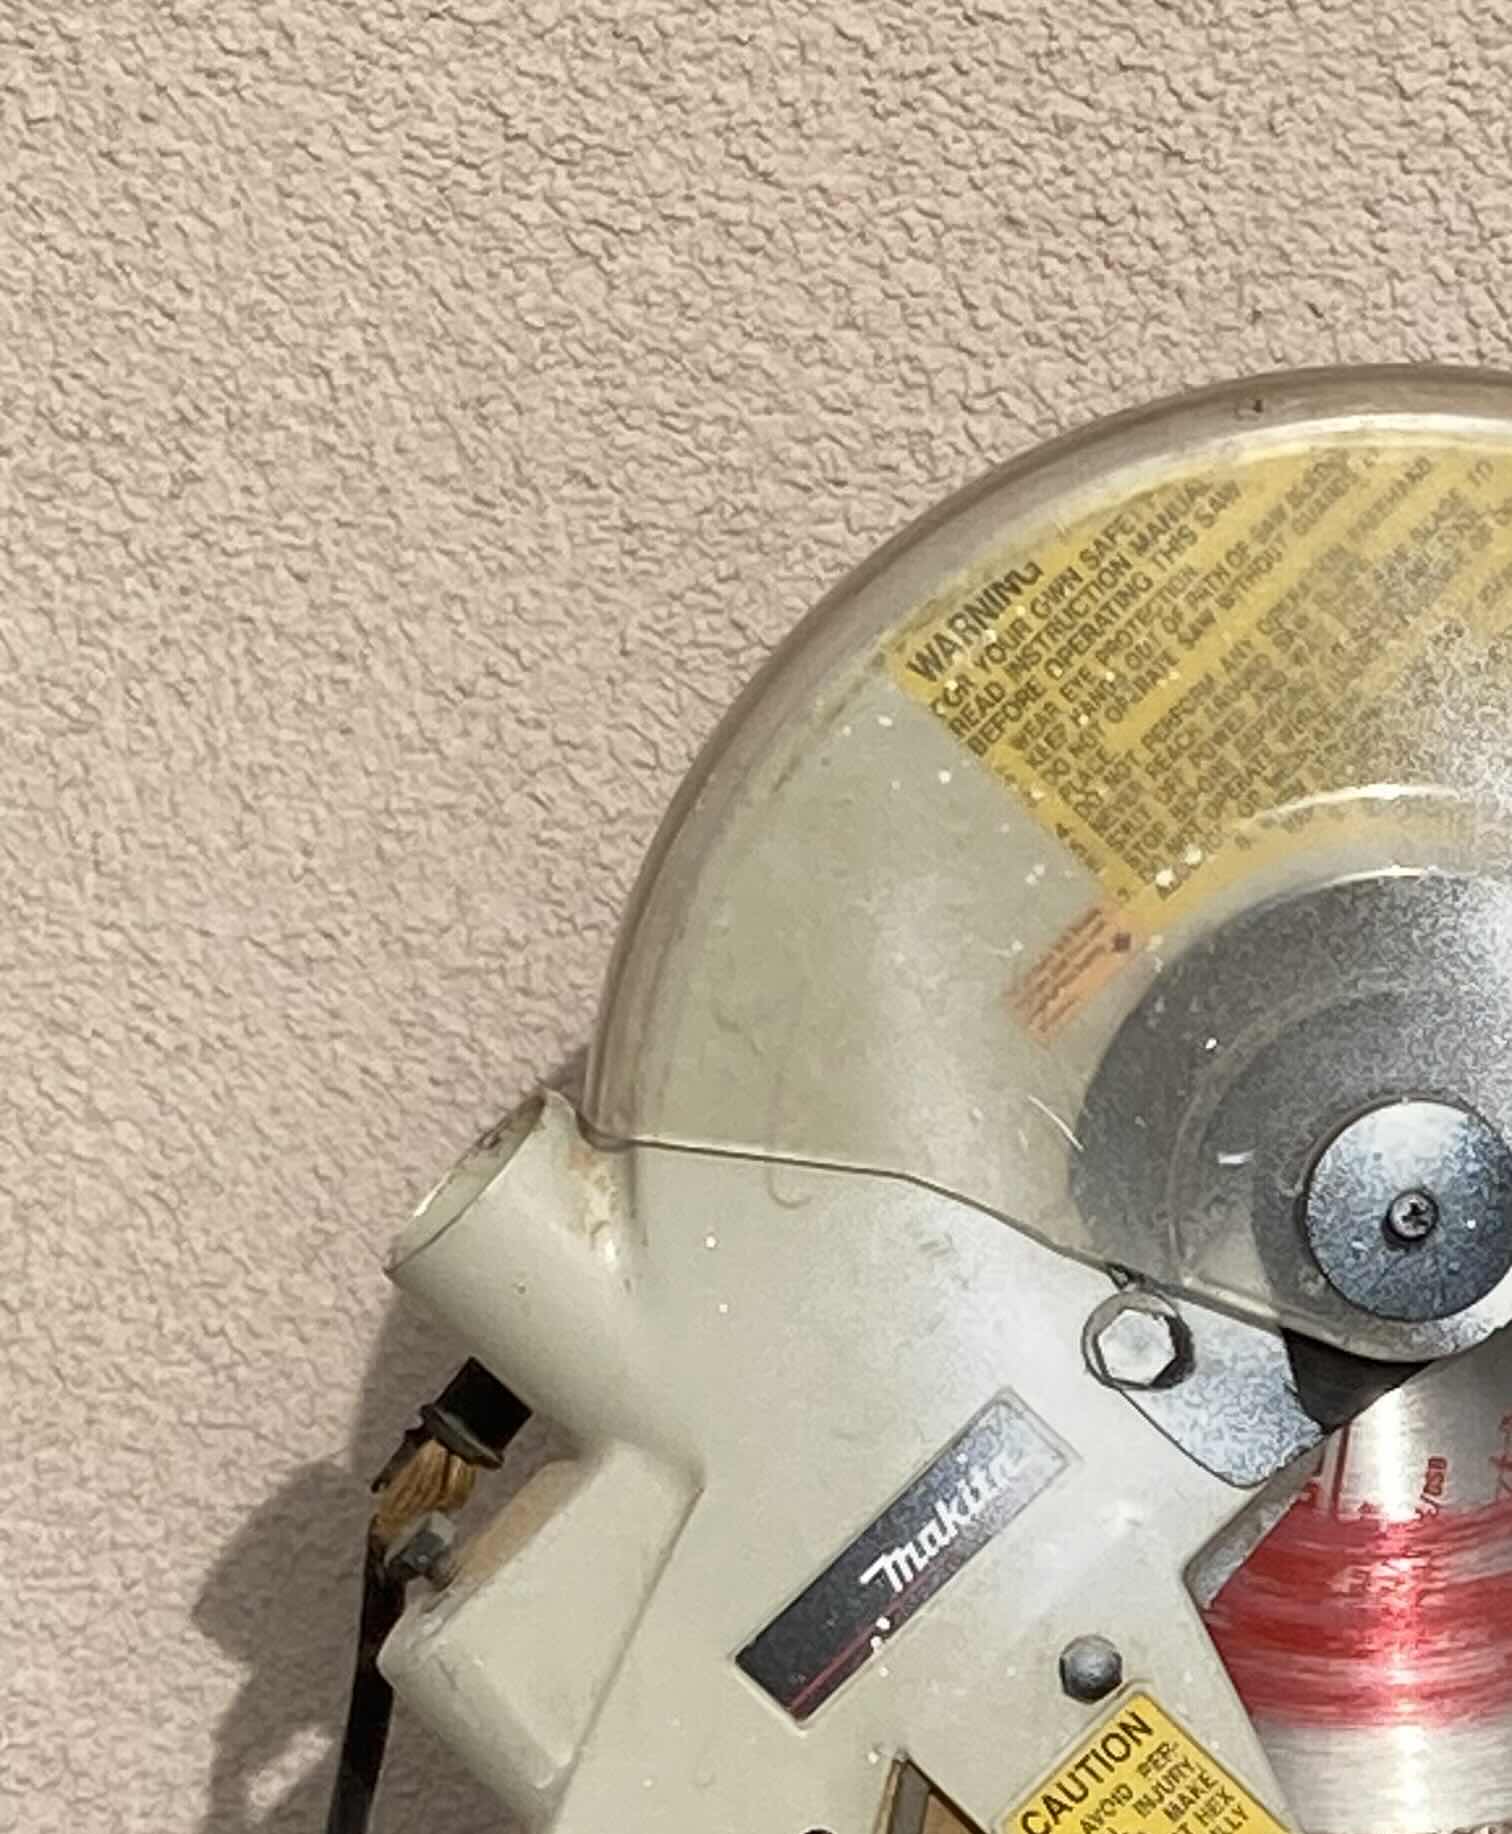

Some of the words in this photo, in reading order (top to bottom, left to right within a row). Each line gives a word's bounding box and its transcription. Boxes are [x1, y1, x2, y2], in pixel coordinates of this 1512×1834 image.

[906, 552, 1041, 686] WARNING
[947, 678, 1007, 737] READ
[1003, 552, 1132, 682] INSTRUCTION
[966, 675, 1047, 757] BEFORE
[1042, 569, 1154, 681] OPERATING
[1151, 524, 1199, 572] THIS
[973, 615, 1032, 675] YOUR
[1123, 631, 1163, 671] OUT
[1008, 700, 1061, 753] WEAR
[1058, 664, 1096, 702] EYE
[1040, 756, 1071, 787] DO
[1067, 719, 1108, 761] NOT
[1164, 1770, 1216, 1822] MAKE
[1194, 1787, 1234, 1826] HEX
